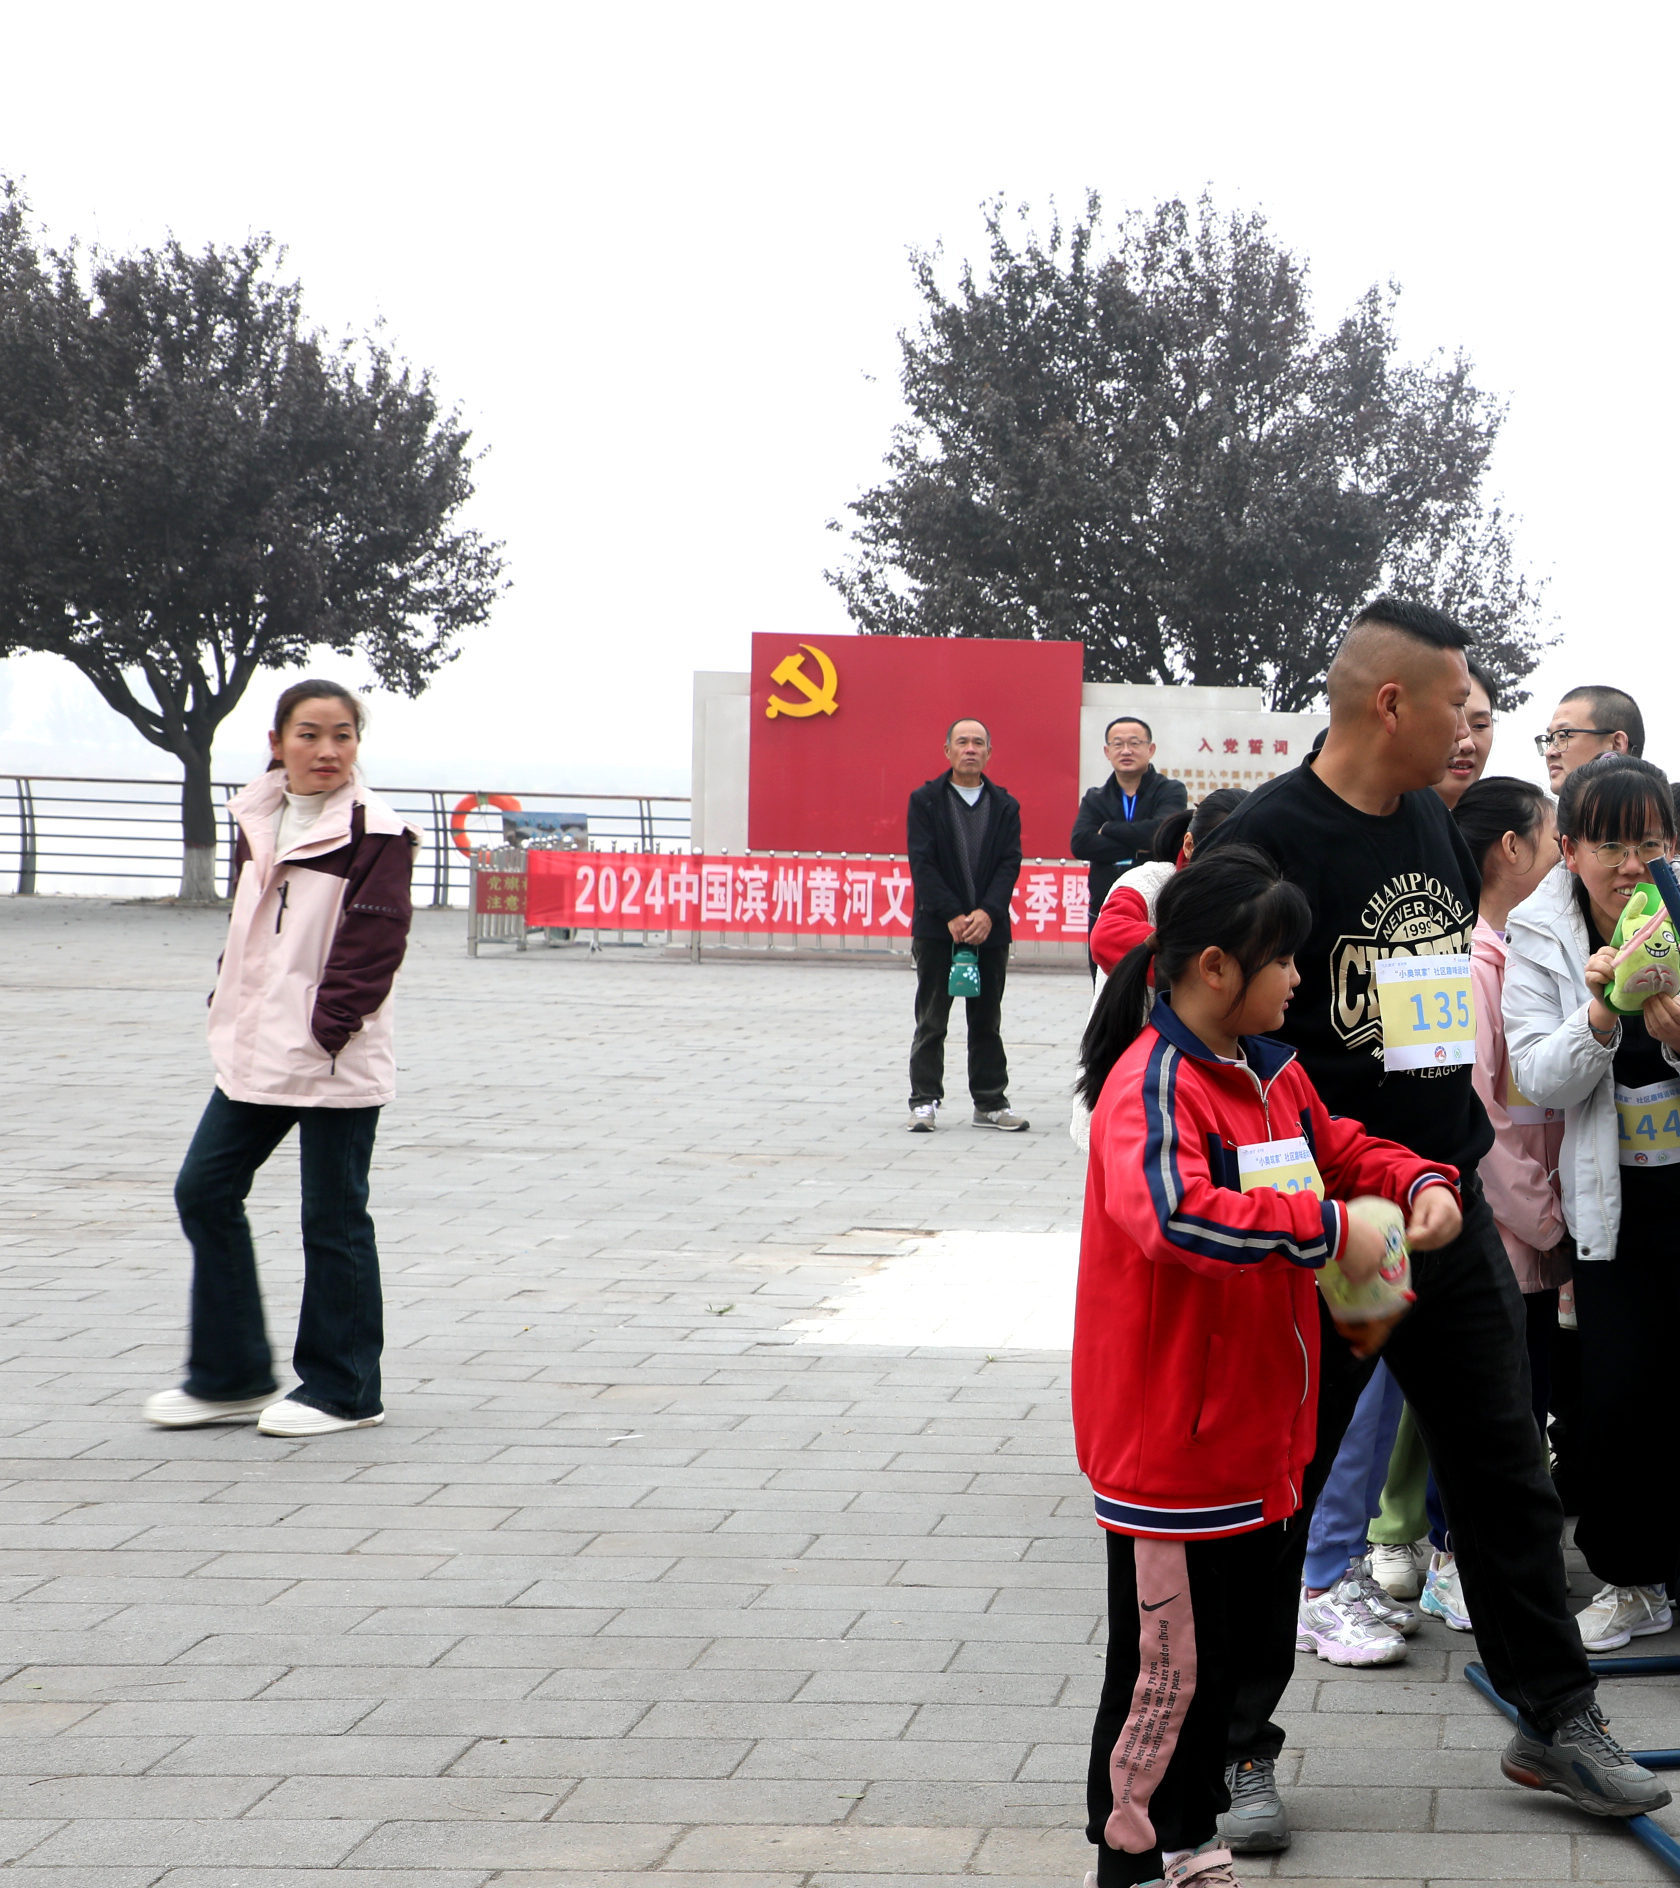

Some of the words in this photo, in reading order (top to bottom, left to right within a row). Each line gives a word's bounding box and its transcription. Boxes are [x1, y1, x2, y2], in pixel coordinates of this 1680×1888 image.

[1198, 737, 1289, 755] 入党誓词
[1361, 872, 1463, 930] CHAMPIONS
[1382, 901, 1427, 941] NEVER
[1428, 903, 1454, 930] SAY
[1402, 920, 1432, 939] 1999
[1410, 990, 1469, 1031] 135
[1124, 1772, 1136, 1787] love
[1133, 1745, 1147, 1761] best
[1141, 1718, 1155, 1746] together
[1155, 1682, 1167, 1695] You
